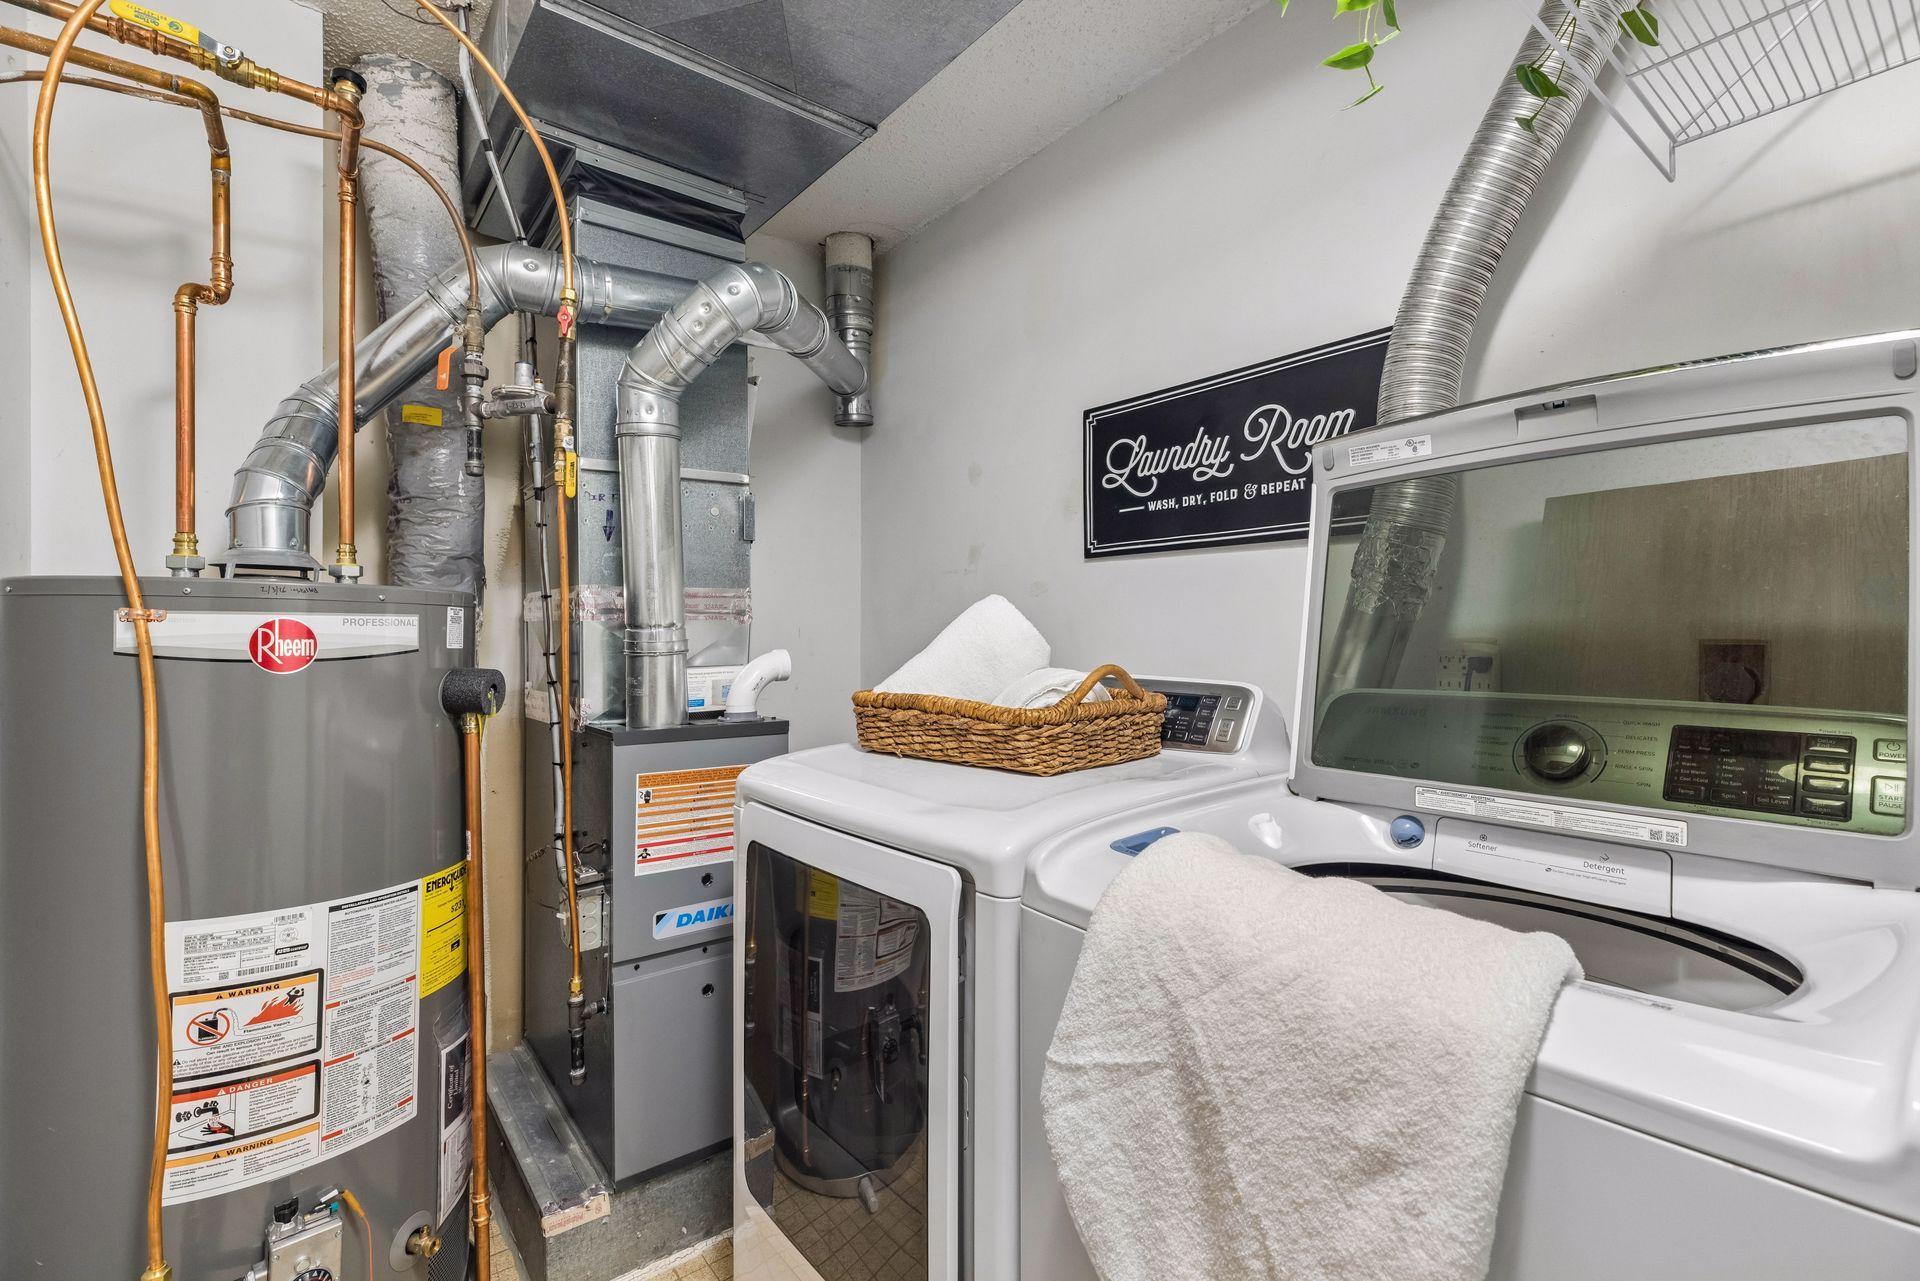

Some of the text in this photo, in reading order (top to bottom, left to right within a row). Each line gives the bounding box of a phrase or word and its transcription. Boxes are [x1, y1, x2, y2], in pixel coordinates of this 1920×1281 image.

[1102, 404, 1355, 497] Laundry Room
[1147, 477, 1306, 512] WASH, DRY, FOLD & REPEAT
[342, 617, 417, 627] PROFESSIONAL
[257, 618, 315, 665] Rheem
[1467, 841, 1497, 852] Softener
[1583, 861, 1625, 875] Detergent
[228, 984, 280, 997] WARNING
[243, 1019, 290, 1034] Flammable Vapors
[229, 1078, 274, 1093] DANGER
[226, 1139, 274, 1156] WARNING
